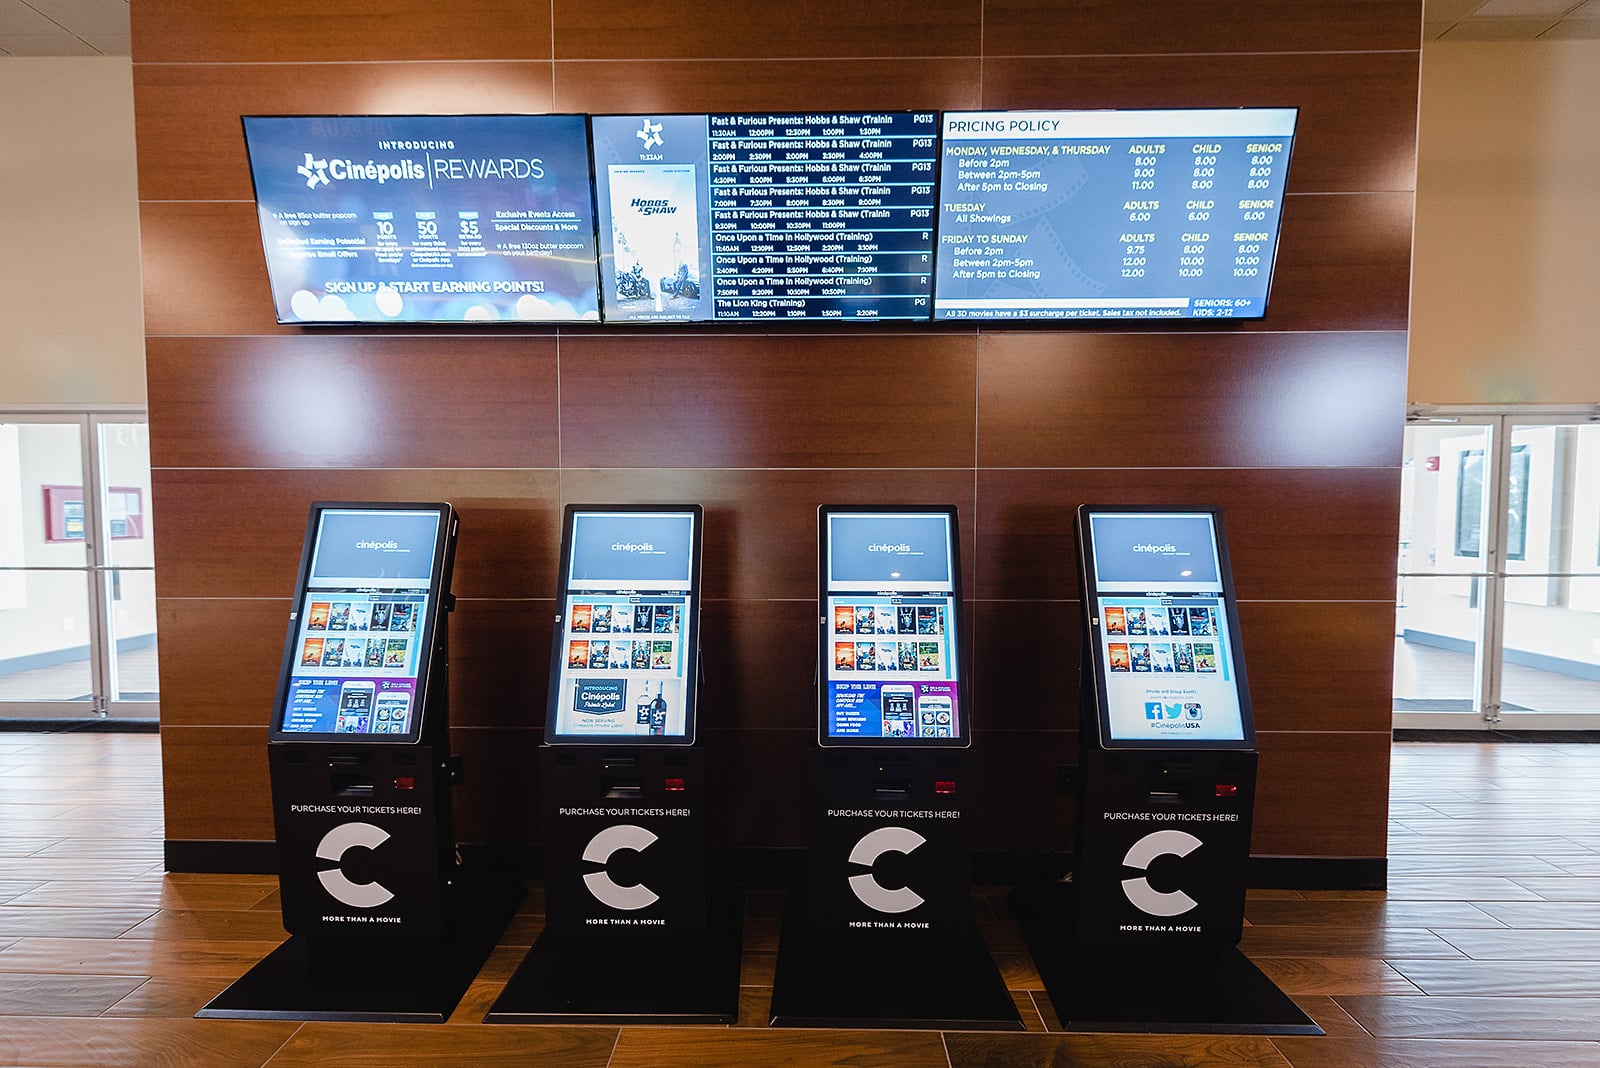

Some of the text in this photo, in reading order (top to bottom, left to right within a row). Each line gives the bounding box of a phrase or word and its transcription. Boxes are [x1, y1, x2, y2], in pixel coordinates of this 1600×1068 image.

[712, 115, 892, 126] Fast & Furious Presents: Hobbs & Shaw (Trainin
[914, 114, 934, 124] PG13
[949, 120, 1060, 132] PRICING POLICY
[822, 128, 844, 136] 1:00PM
[378, 140, 455, 150] INTRODUCING
[1128, 144, 1166, 154] ADULTS
[1192, 144, 1222, 154] CHILD
[1246, 144, 1282, 154] SENIOR
[946, 146, 1111, 156] MONDAY, WEDNESDAY, & THURSDAY
[959, 158, 1010, 168] Before 2pm
[1135, 156, 1156, 166] 8.00
[1194, 156, 1216, 166] 8.00
[1252, 156, 1273, 165] 8.00
[329, 158, 544, 183] Cinépolis REWARDS
[958, 170, 1040, 180] Between 2pm-5pm
[1134, 168, 1154, 178] 9.00
[1193, 168, 1214, 178] 8.00
[1250, 168, 1271, 177] 8.00
[958, 182, 1048, 192] After 5pm to Closing
[1132, 180, 1154, 190] 11.00
[1192, 180, 1213, 190] 8.00
[1248, 180, 1269, 188] 8.00
[944, 204, 986, 212] TUESDAY
[1123, 200, 1160, 210] ADULTS
[1186, 200, 1214, 210] CHILD
[1238, 200, 1274, 209] SENIOR
[643, 206, 677, 216] SHAW
[1244, 212, 1265, 220] 6.00
[956, 214, 1012, 224] All Showings
[1130, 212, 1150, 222] 6.00
[1188, 212, 1210, 221] 6.00
[376, 221, 394, 235] 10
[417, 221, 438, 235] 50
[460, 220, 479, 235] $5
[942, 234, 1028, 244] FRIDAY TO SUNDAY
[1120, 233, 1156, 242] ADULTS
[1182, 233, 1210, 242] CHILD
[1234, 232, 1269, 242] SENIOR
[954, 247, 1004, 256] Before 2pm
[1126, 246, 1146, 254] 9.75
[1184, 245, 1204, 254] 8.00
[1238, 244, 1260, 254] 8.00
[954, 258, 1034, 268] Between 2pm-5pm
[1122, 257, 1146, 266] 12.00
[1180, 256, 1204, 266] 10.00
[1235, 256, 1260, 266] 10.00
[952, 270, 1040, 279] After 5pm to Closing
[1122, 268, 1145, 278] 12.00
[1178, 268, 1203, 278] 10.00
[1233, 268, 1258, 277] 10.00
[325, 281, 544, 294] SIGN UP & START EARNING POINTS!
[717, 299, 806, 308] The Lion King (Training)
[914, 298, 926, 306] PG
[1234, 299, 1252, 307] 60+
[1030, 310, 1065, 318] surcharge
[356, 540, 398, 550] cinépolis
[612, 542, 654, 552] cinépolis
[868, 543, 910, 554] cinépolis
[1132, 543, 1176, 554] cinépolis
[581, 692, 620, 702] Cinépolis
[291, 804, 422, 814] PURCHASE YOUR TICKETS HERE!
[560, 808, 604, 816] PURCHASE
[666, 808, 690, 816] HERE!
[828, 810, 874, 818] PURCHASE
[874, 810, 898, 818] YOUR
[900, 810, 934, 818] TICKETS
[1104, 812, 1150, 820] PURCHASE
[1177, 813, 1212, 821] TICKETS
[1212, 814, 1238, 822] HERE!
